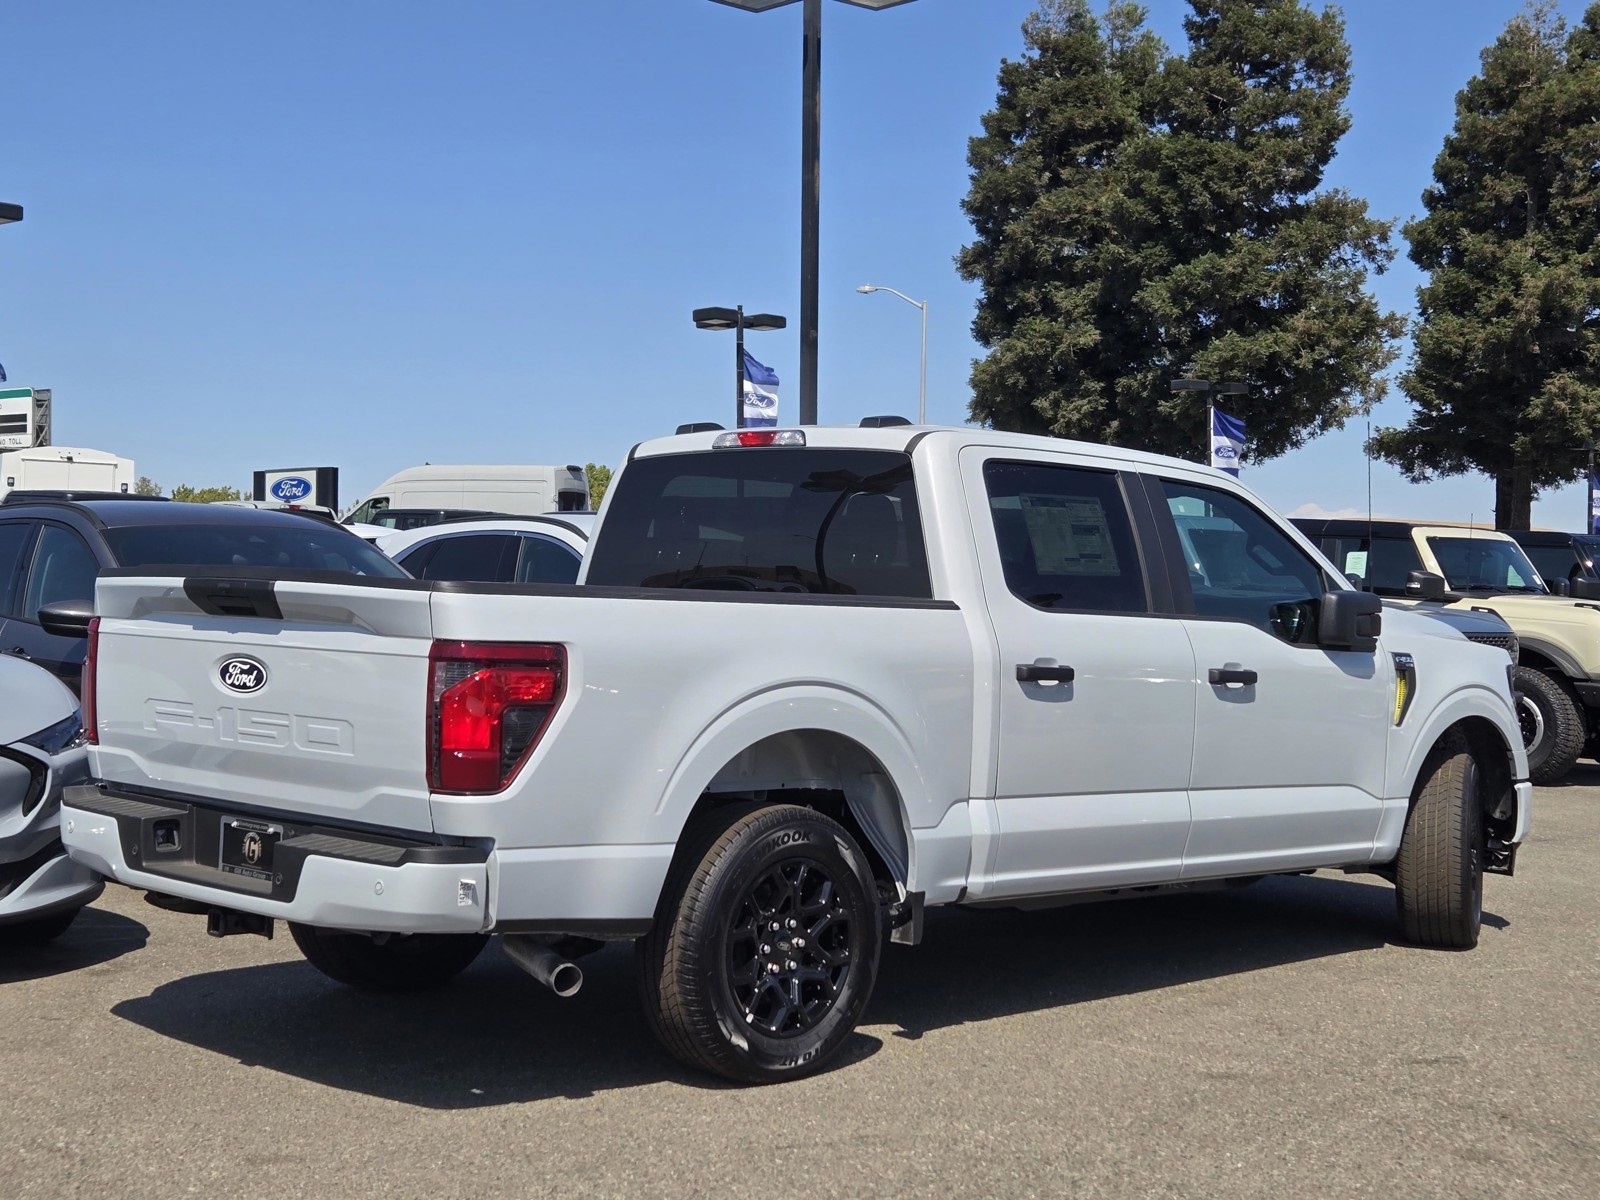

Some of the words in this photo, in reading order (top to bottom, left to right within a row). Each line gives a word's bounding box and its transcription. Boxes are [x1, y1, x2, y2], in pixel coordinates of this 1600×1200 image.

[745, 393, 768, 408] Ford
[278, 480, 304, 497] Ford
[225, 662, 258, 687] Ford
[143, 698, 355, 757] F-150
